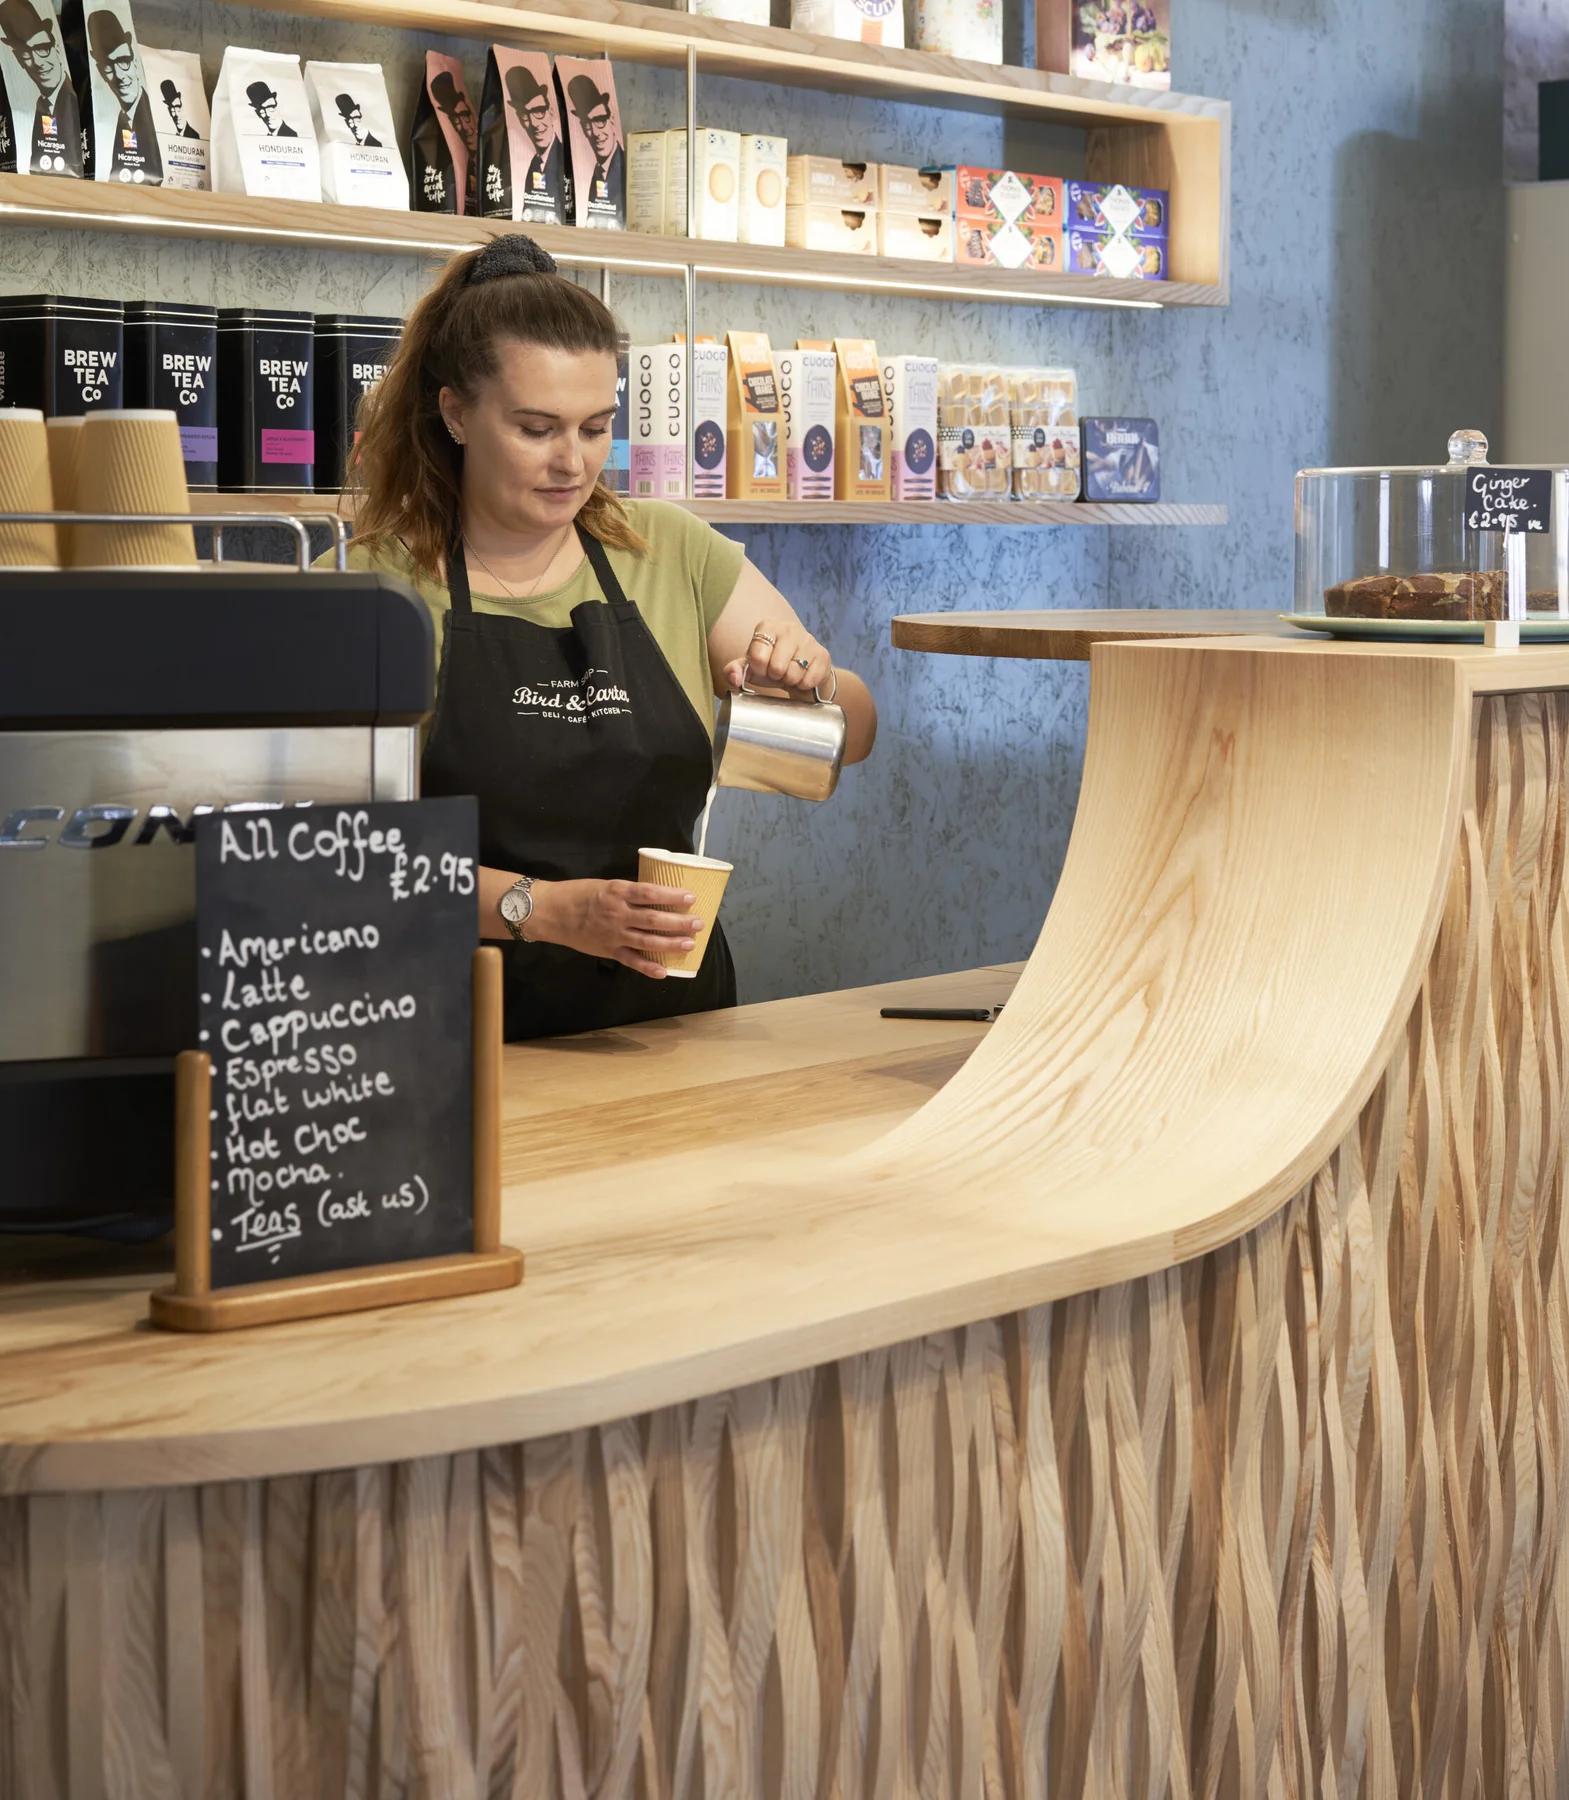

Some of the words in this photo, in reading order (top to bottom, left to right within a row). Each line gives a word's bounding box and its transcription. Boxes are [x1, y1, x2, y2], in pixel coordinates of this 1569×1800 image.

[168, 144, 205, 157] HONDURAN
[258, 143, 304, 155] HONDURAN
[350, 152, 389, 164] HONDURAN
[64, 349, 117, 368] BREW
[162, 354, 212, 372] BREW
[803, 356, 836, 368] CUOCO
[73, 367, 109, 385] TEA
[259, 359, 309, 377] BREW
[171, 372, 205, 389] TEA
[268, 376, 301, 394] TEA
[81, 386, 102, 403] Co
[179, 390, 198, 406] Co
[276, 394, 295, 410] Co
[640, 354, 652, 438] CUOCO
[669, 353, 681, 437] CUOCO
[1472, 473, 1530, 498] Ginger
[550, 680, 579, 688] FARM
[512, 686, 564, 708] Bird
[565, 695, 587, 712] &
[542, 711, 560, 719] DELI
[567, 715, 587, 724] CAFÉ
[591, 706, 621, 718] KITCHEN
[220, 817, 279, 864] All
[288, 810, 406, 882] Coffee
[389, 851, 475, 902] £2.95
[218, 922, 380, 968] Americano
[221, 966, 311, 1010] Latte
[221, 992, 416, 1056] Cappuccino
[225, 1043, 358, 1093] Espresso
[302, 1071, 395, 1109] white
[225, 1127, 281, 1164] Hot
[294, 1116, 367, 1155] Choc
[317, 1189, 371, 1228] (ask
[382, 1174, 430, 1216] us)
